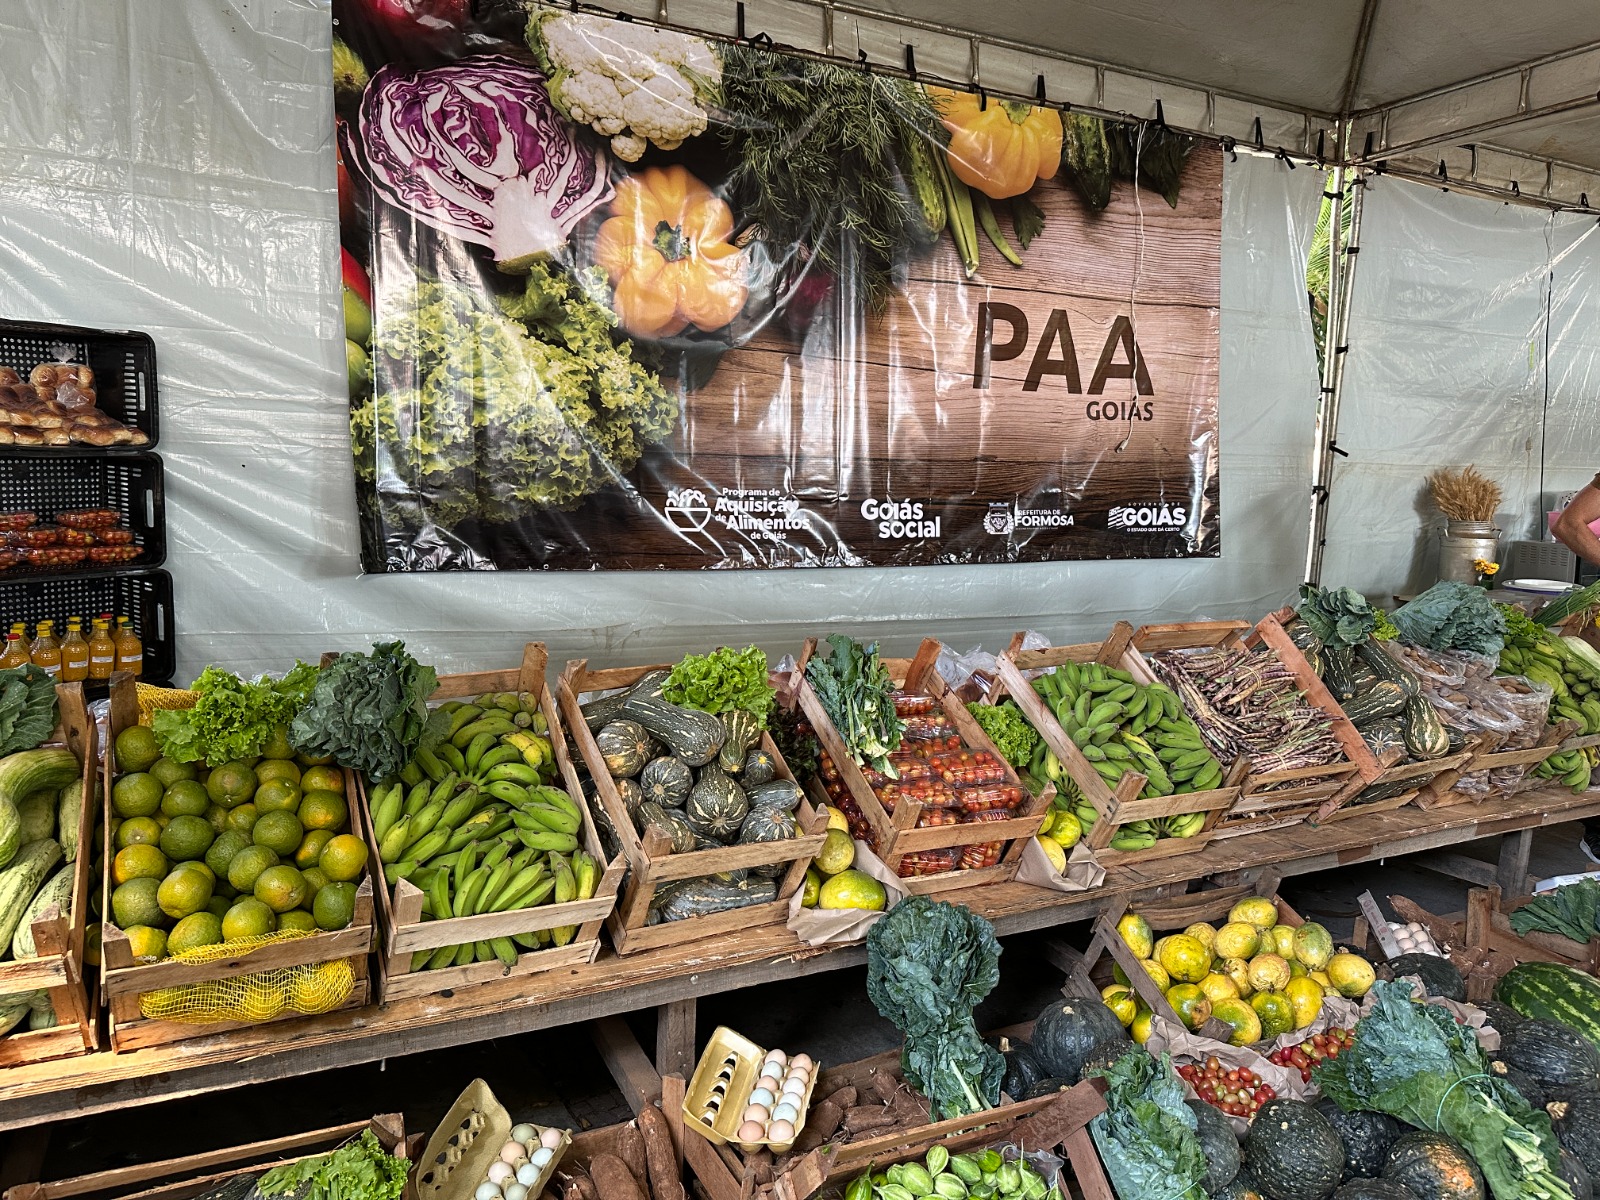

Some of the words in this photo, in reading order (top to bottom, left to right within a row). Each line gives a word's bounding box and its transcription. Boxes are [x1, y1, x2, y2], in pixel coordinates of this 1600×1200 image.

[973, 302, 1154, 396] PAA
[1086, 395, 1154, 421] GOIÁS
[722, 487, 768, 498] Programa
[768, 487, 780, 496] de
[860, 497, 924, 520] Goiás
[1122, 503, 1187, 526] GOIÁS
[715, 513, 727, 522] de
[726, 514, 810, 530] Alimentos
[878, 516, 941, 538] social
[1014, 514, 1075, 527] FORMOSA
[750, 531, 761, 539] de
[762, 531, 787, 540] Goiás
